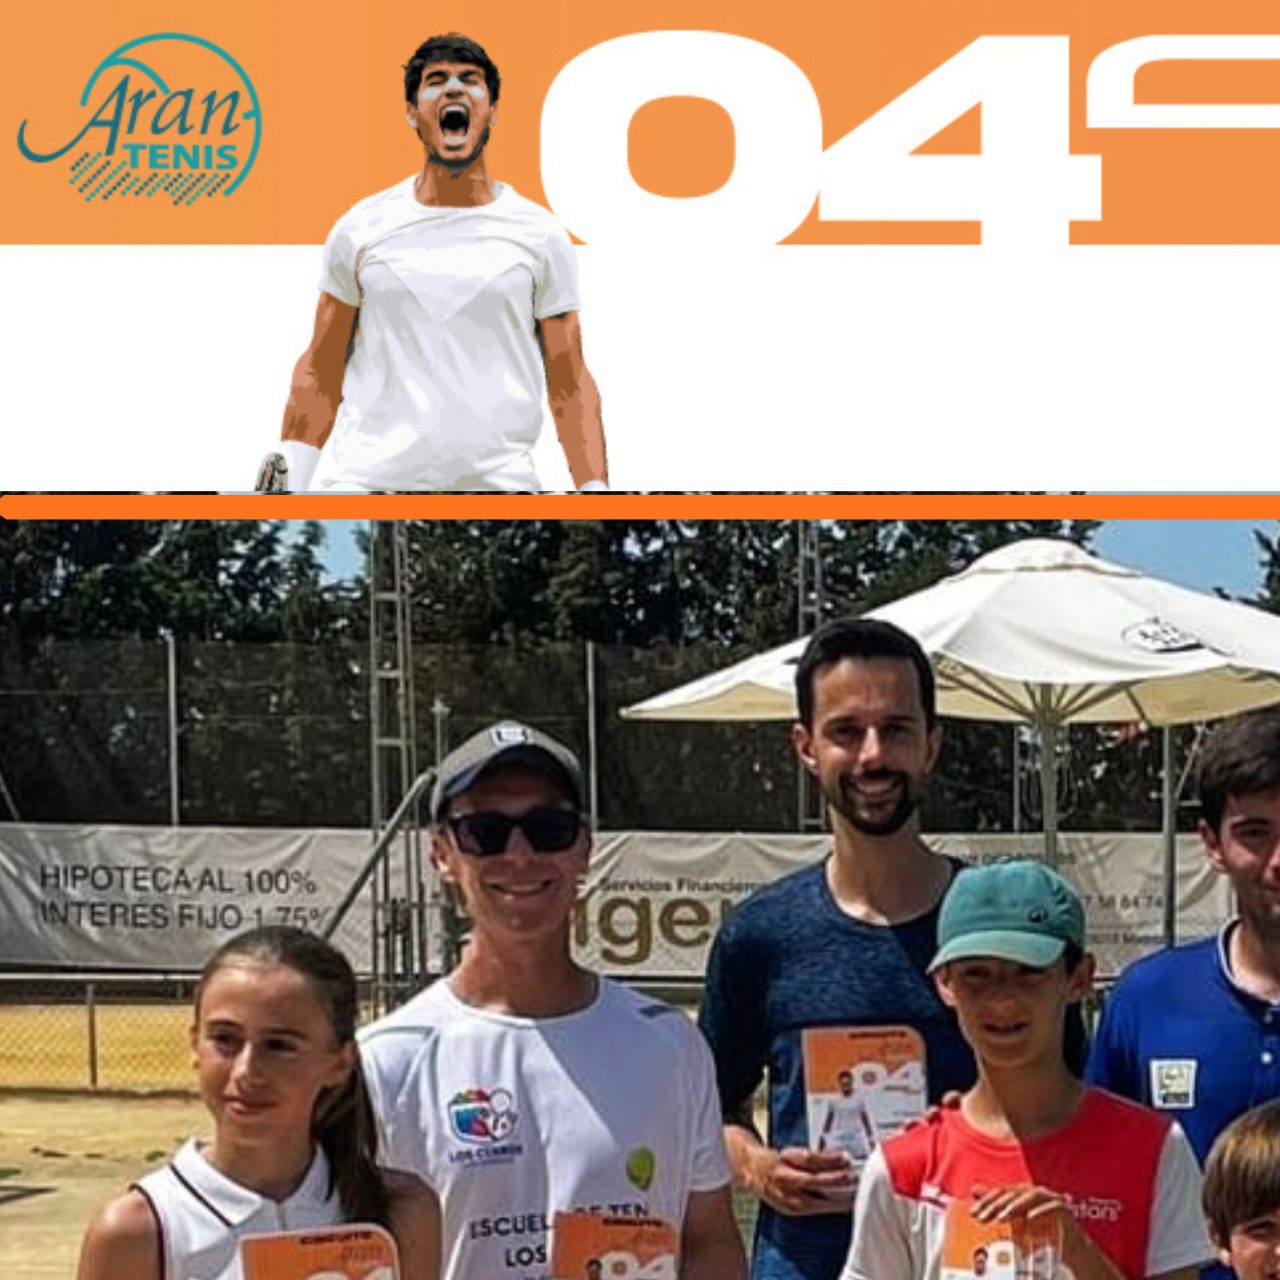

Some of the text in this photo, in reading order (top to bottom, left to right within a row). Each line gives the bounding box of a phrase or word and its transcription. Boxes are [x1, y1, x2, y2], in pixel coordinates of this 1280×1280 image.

[41, 865, 317, 894] HIPOTECA AL 100%
[179, 903, 244, 930] FIJO
[469, 1213, 557, 1240] ESCUEL
[505, 1244, 547, 1268] LOS
